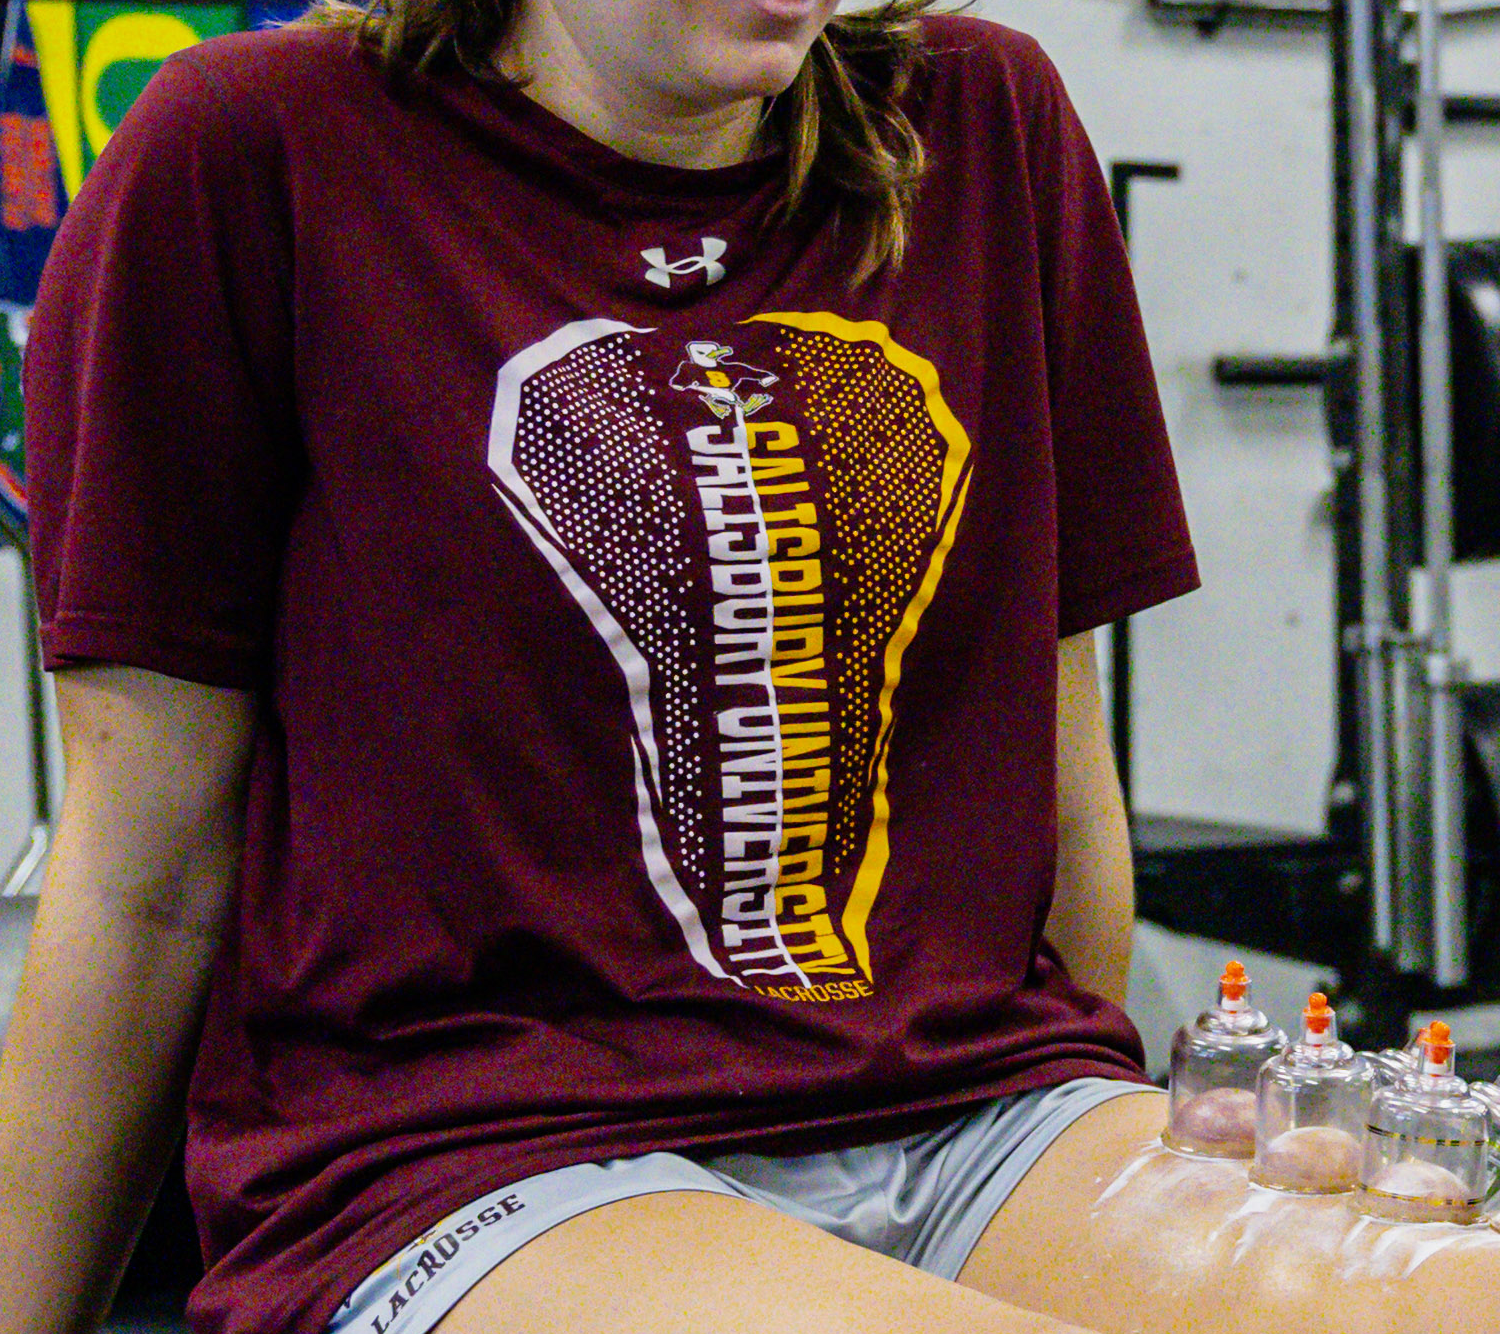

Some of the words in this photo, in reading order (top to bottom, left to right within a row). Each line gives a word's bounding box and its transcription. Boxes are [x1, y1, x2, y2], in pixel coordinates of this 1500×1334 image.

[685, 419, 829, 691] SALISBURY
[716, 701, 858, 980] UNIVERSITY
[753, 978, 872, 1005] LACROSSE
